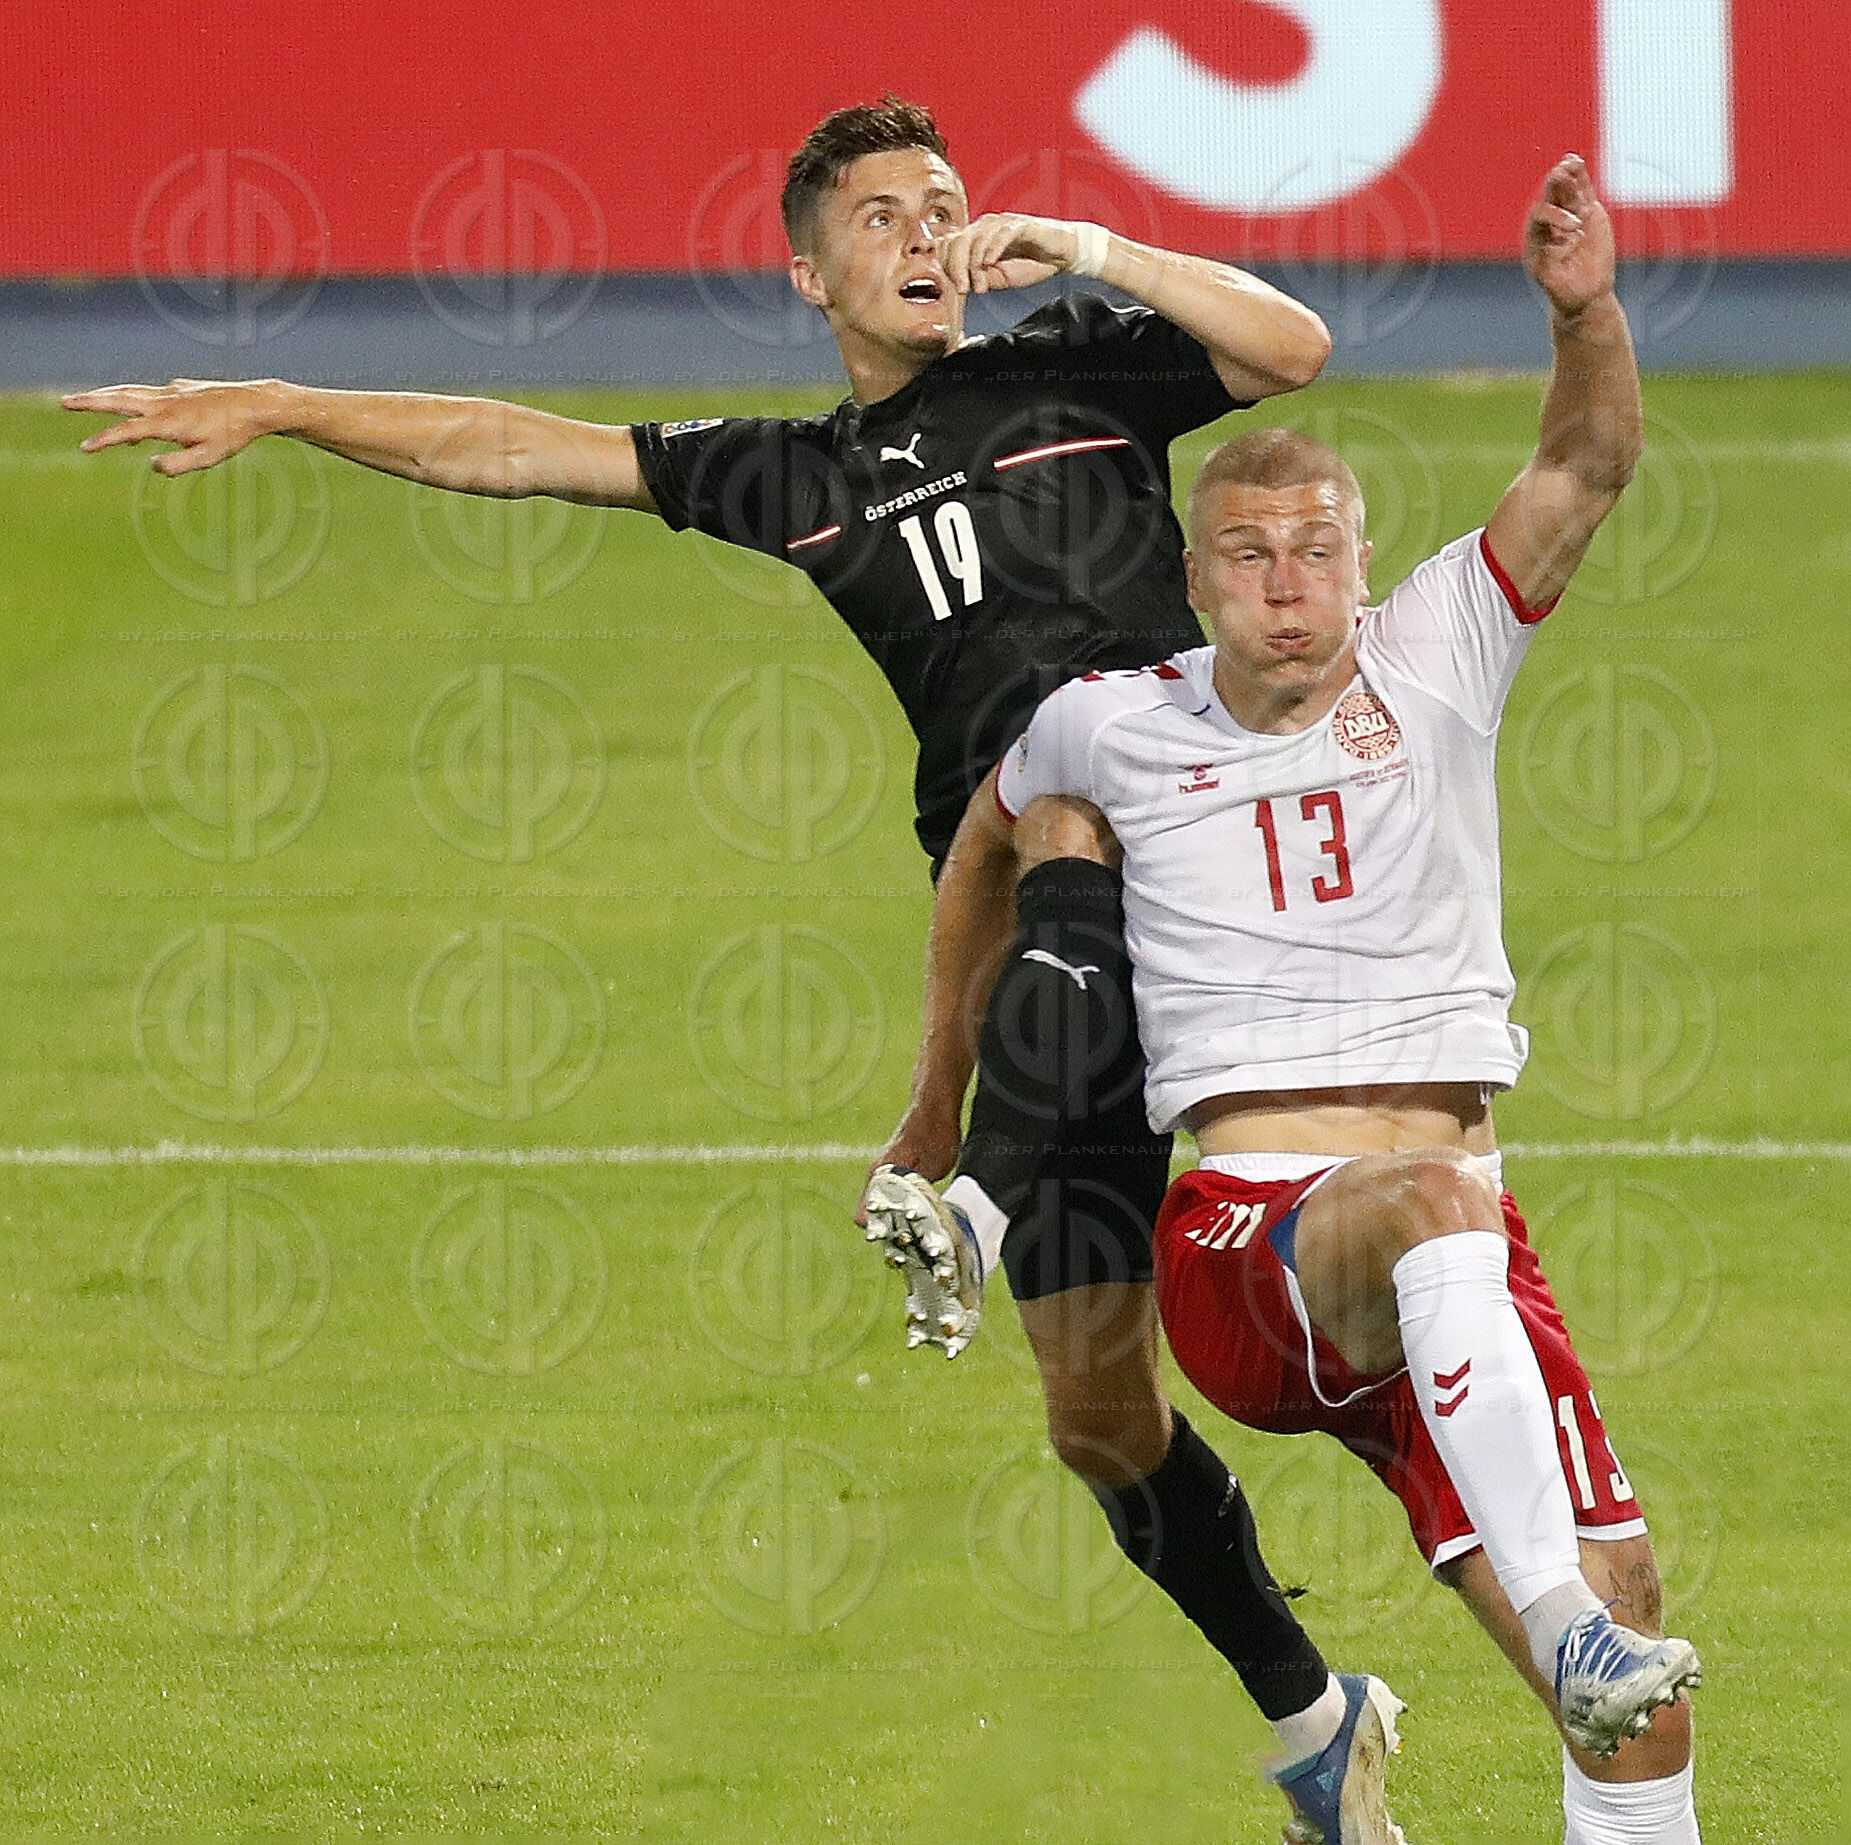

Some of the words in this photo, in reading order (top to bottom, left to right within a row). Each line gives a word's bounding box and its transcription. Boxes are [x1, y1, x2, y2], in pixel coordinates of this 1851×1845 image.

[864, 471, 968, 521] ÖSTERREICH
[897, 500, 983, 621] 19
[1344, 711, 1389, 740] DBU
[1255, 791, 1354, 912] 13
